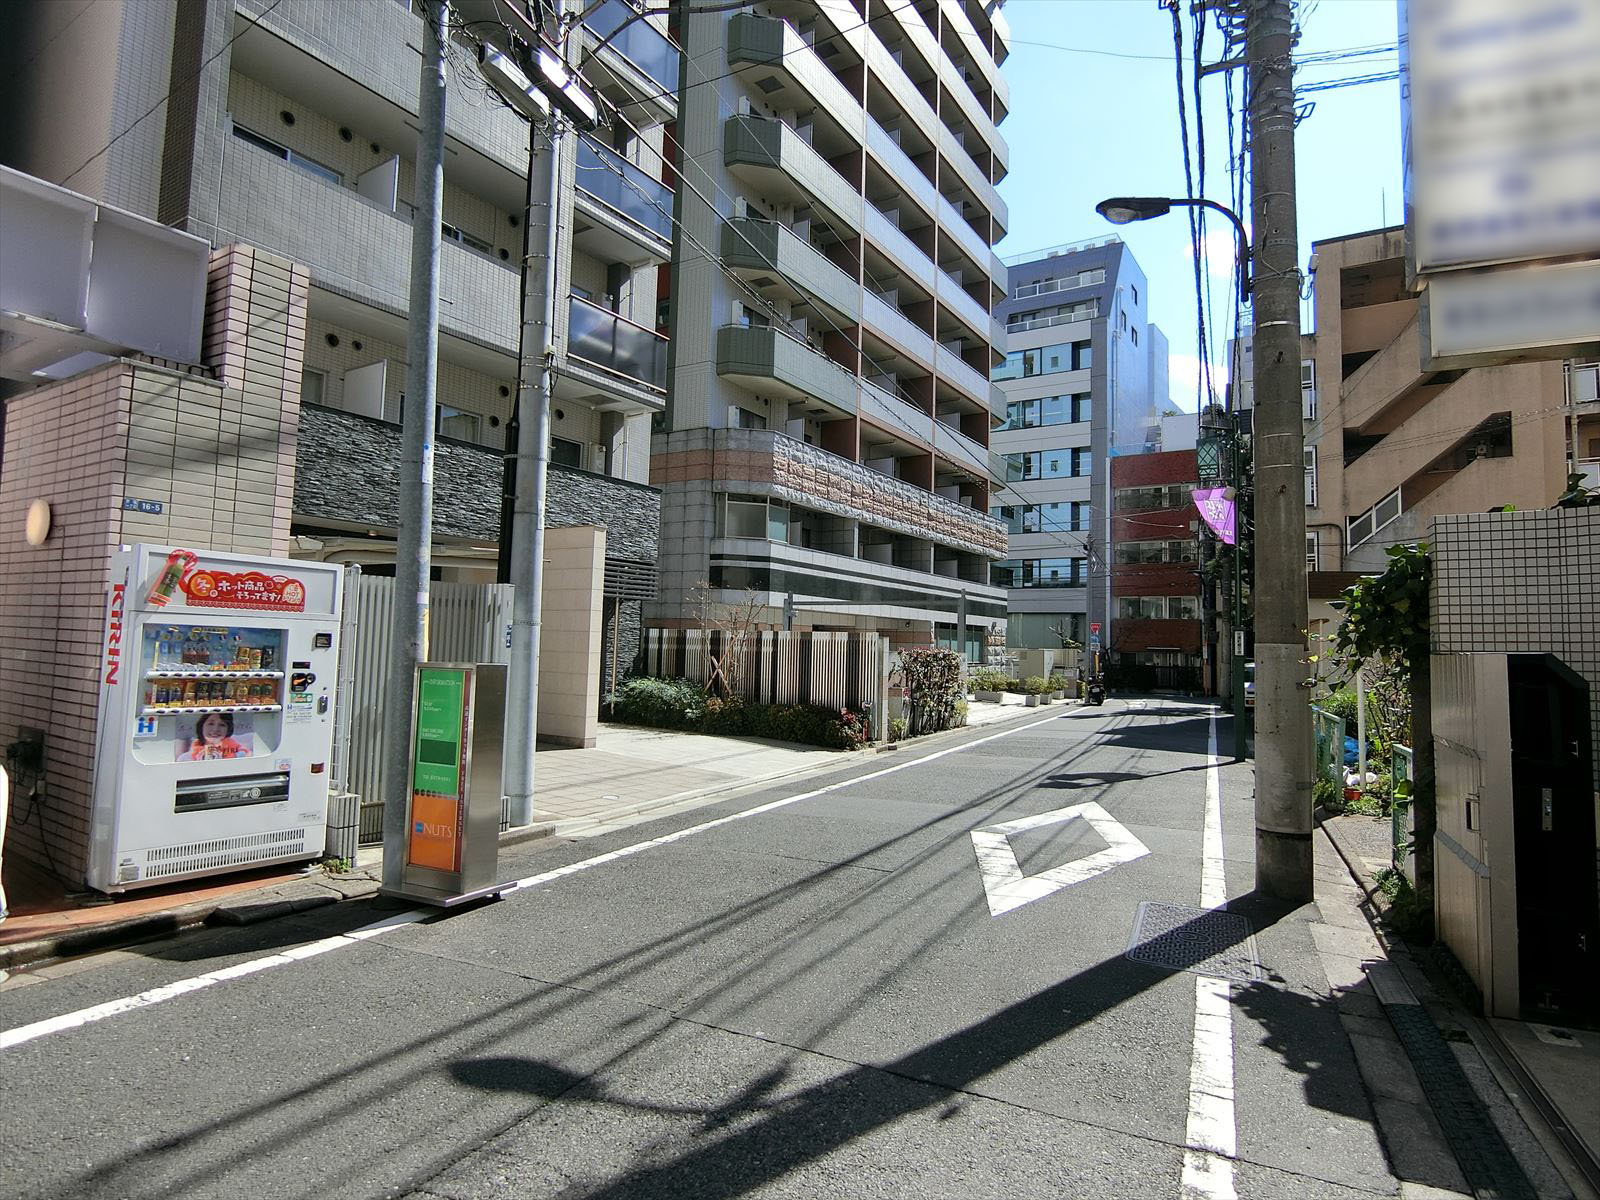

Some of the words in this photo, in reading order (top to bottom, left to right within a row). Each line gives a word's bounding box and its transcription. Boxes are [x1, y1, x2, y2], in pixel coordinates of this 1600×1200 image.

[142, 502, 161, 512] 16-5
[217, 580, 265, 592] ホット商品
[105, 584, 125, 685] KIRIN
[423, 822, 453, 838] NUTS
